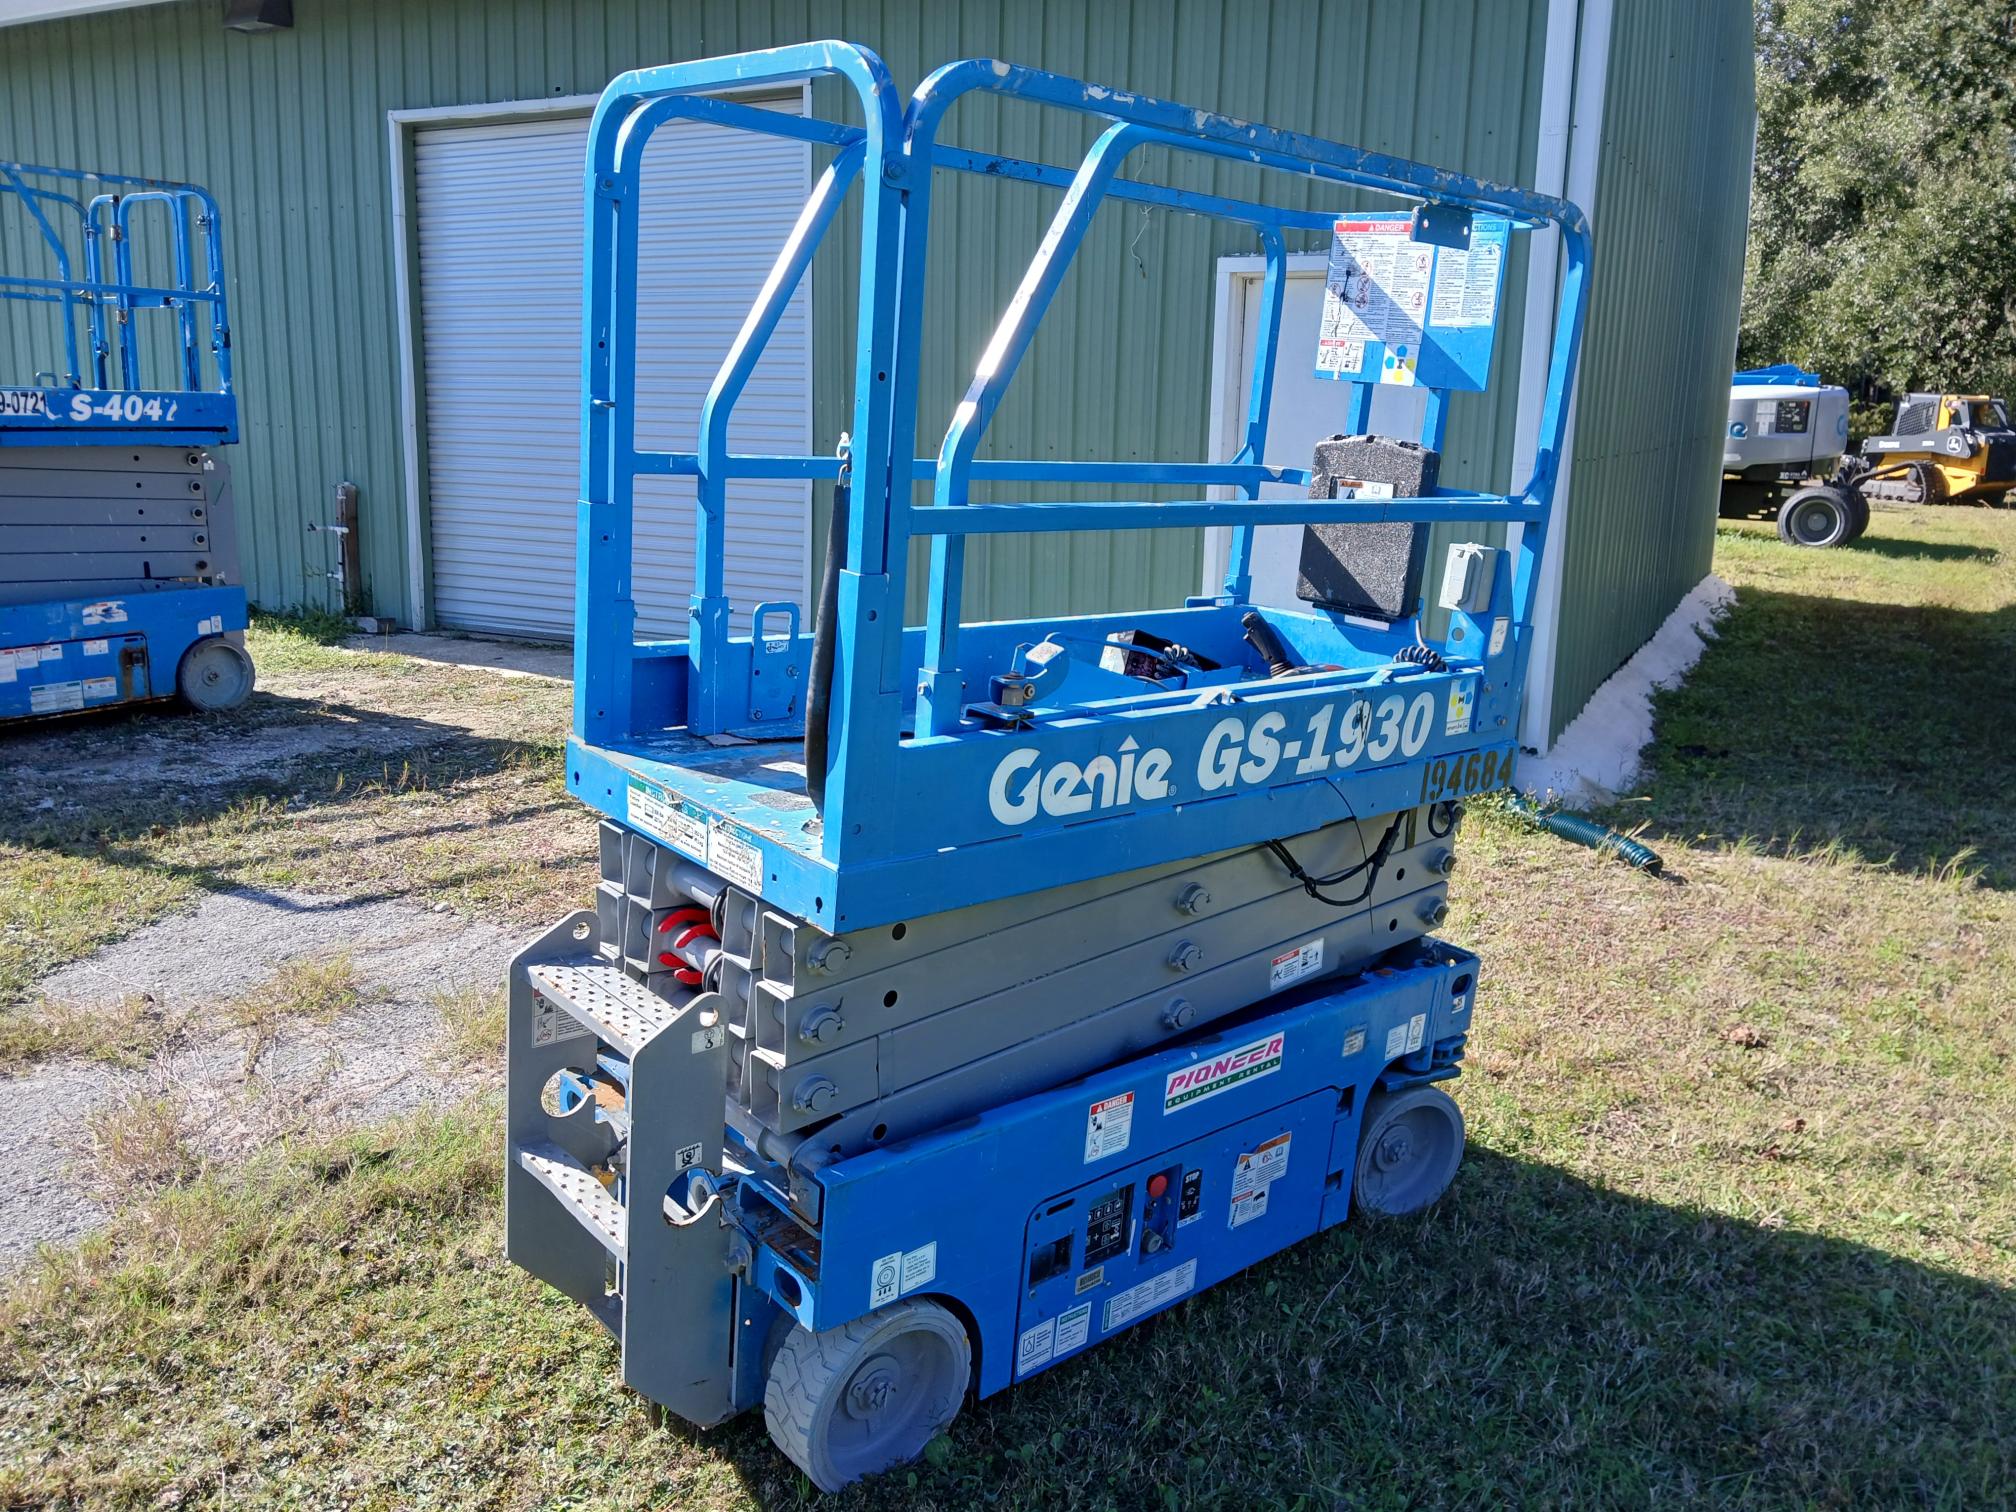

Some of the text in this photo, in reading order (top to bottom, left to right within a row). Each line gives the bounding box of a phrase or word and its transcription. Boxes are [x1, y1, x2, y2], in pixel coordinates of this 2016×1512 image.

[1375, 223, 1404, 232] DANGER
[989, 691, 1435, 826] Genie GS-1930
[1420, 747, 1515, 803] 194684
[1166, 1059, 1279, 1107] EQUIPMENT RENTAL
[1167, 1037, 1283, 1096] PIONEER
[1103, 1095, 1128, 1111] DANGER
[1185, 1171, 1200, 1184] STOP
